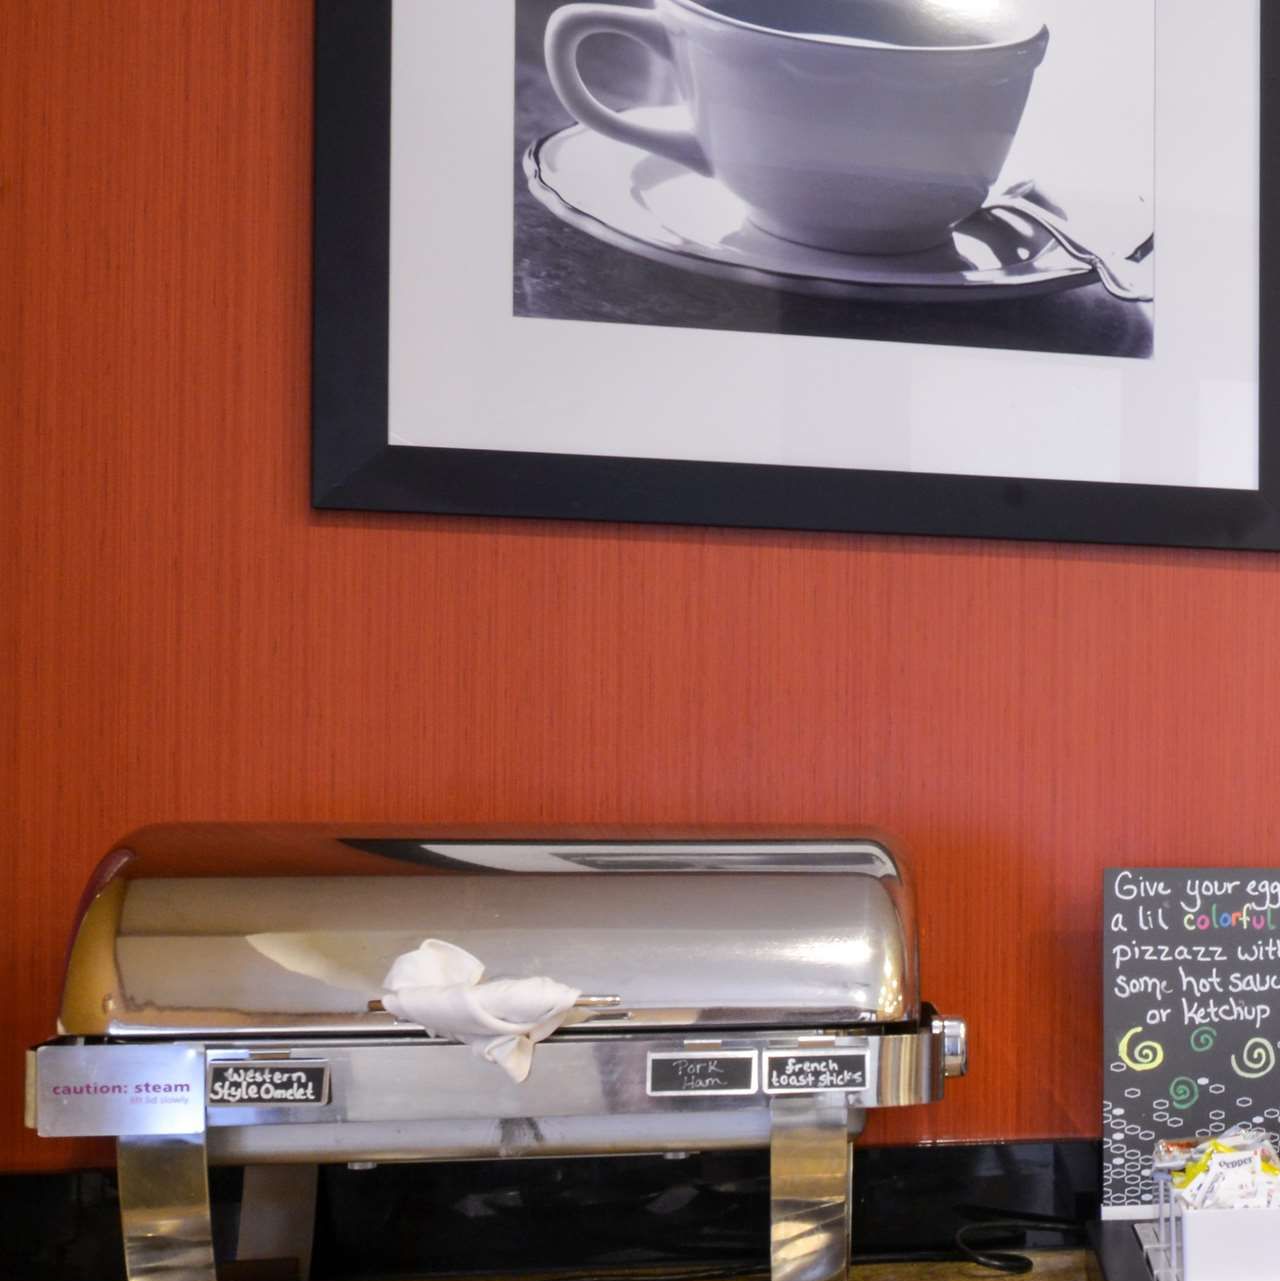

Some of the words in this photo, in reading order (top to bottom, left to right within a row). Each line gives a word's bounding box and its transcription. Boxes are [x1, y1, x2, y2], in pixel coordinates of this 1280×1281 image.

[1114, 871, 1171, 900] Give
[1180, 880, 1240, 912] your
[1111, 913, 1127, 931] a
[1138, 905, 1168, 930] lil
[1183, 903, 1276, 930] colorful
[1112, 941, 1227, 969] pizzazz
[1114, 974, 1173, 1000] some
[1178, 966, 1223, 997] hot
[1146, 1008, 1171, 1024] or
[224, 1067, 306, 1084] Western
[771, 1070, 814, 1086] toast
[818, 1069, 863, 1087] sticks
[52, 1082, 128, 1096] caution:
[134, 1082, 190, 1094] steam
[209, 1081, 258, 1102] Style
[1218, 1156, 1253, 1168] Pepper
